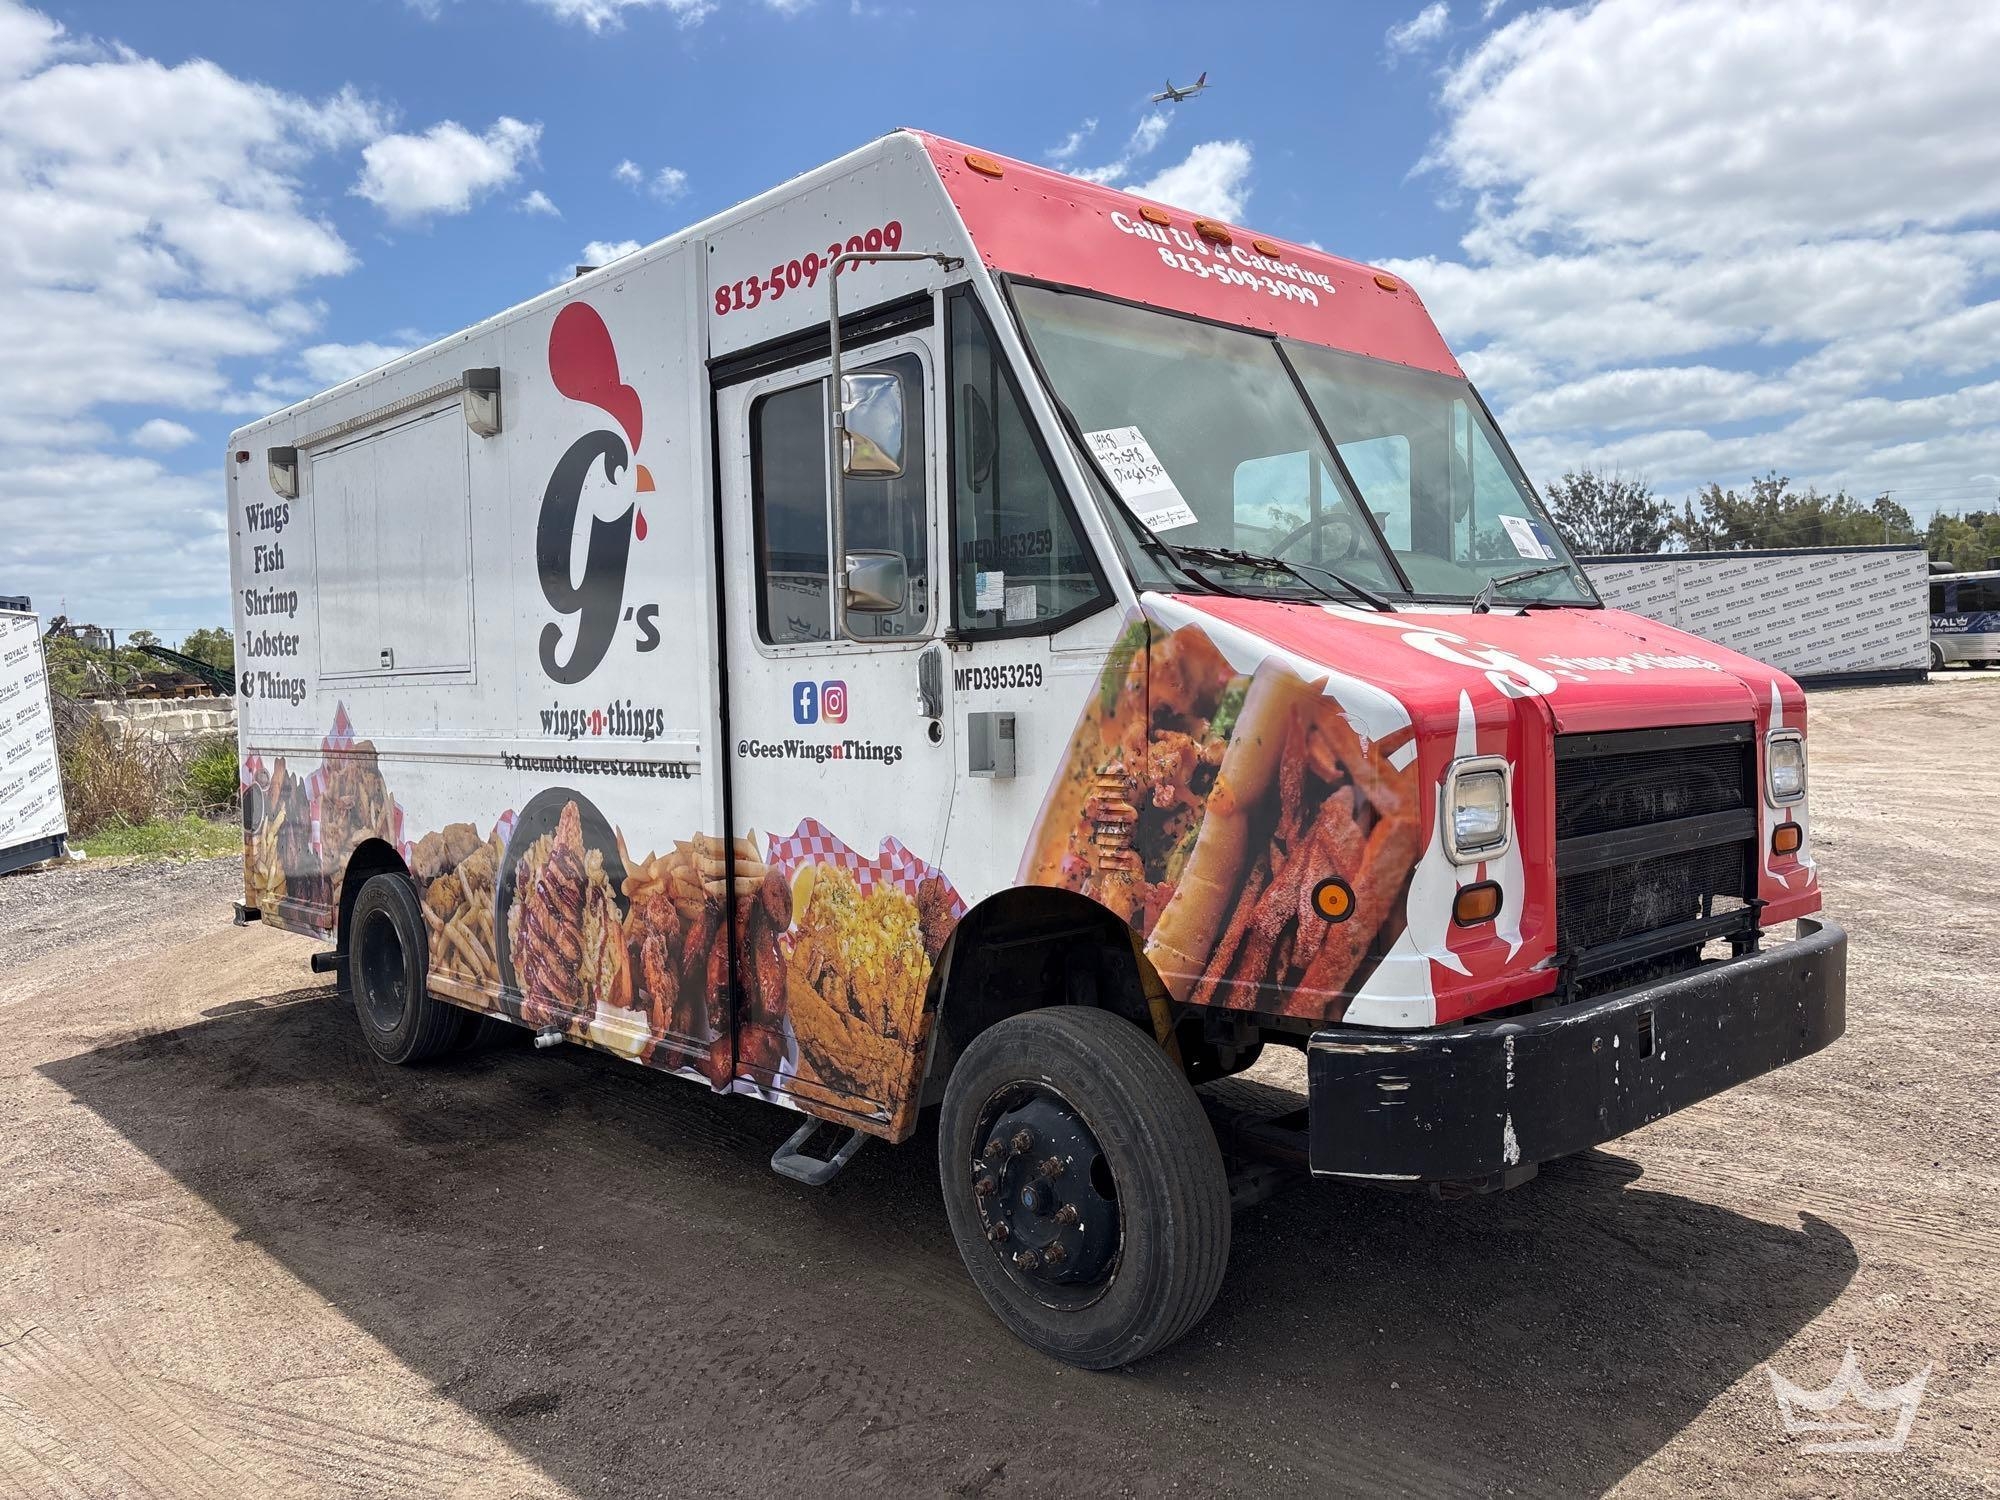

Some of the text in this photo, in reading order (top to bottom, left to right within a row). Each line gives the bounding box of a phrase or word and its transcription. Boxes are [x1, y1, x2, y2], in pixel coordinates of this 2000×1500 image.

[1157, 247, 1319, 307] 813-509-3999
[1231, 246, 1336, 294] Catering
[245, 502, 290, 534] Wings
[254, 542, 284, 574] Fish
[245, 587, 298, 619] Shrimp
[247, 630, 299, 657] Lobster
[0, 684, 14, 697] OYAL
[240, 671, 306, 706] & Things
[954, 663, 1042, 691] MFD3953259
[35, 727, 51, 741] ROYA
[737, 739, 903, 765] @GeesWingsnThings
[28, 761, 48, 778] ROYAL
[47, 784, 59, 796] ROY
[19, 799, 38, 818] ROYAL
